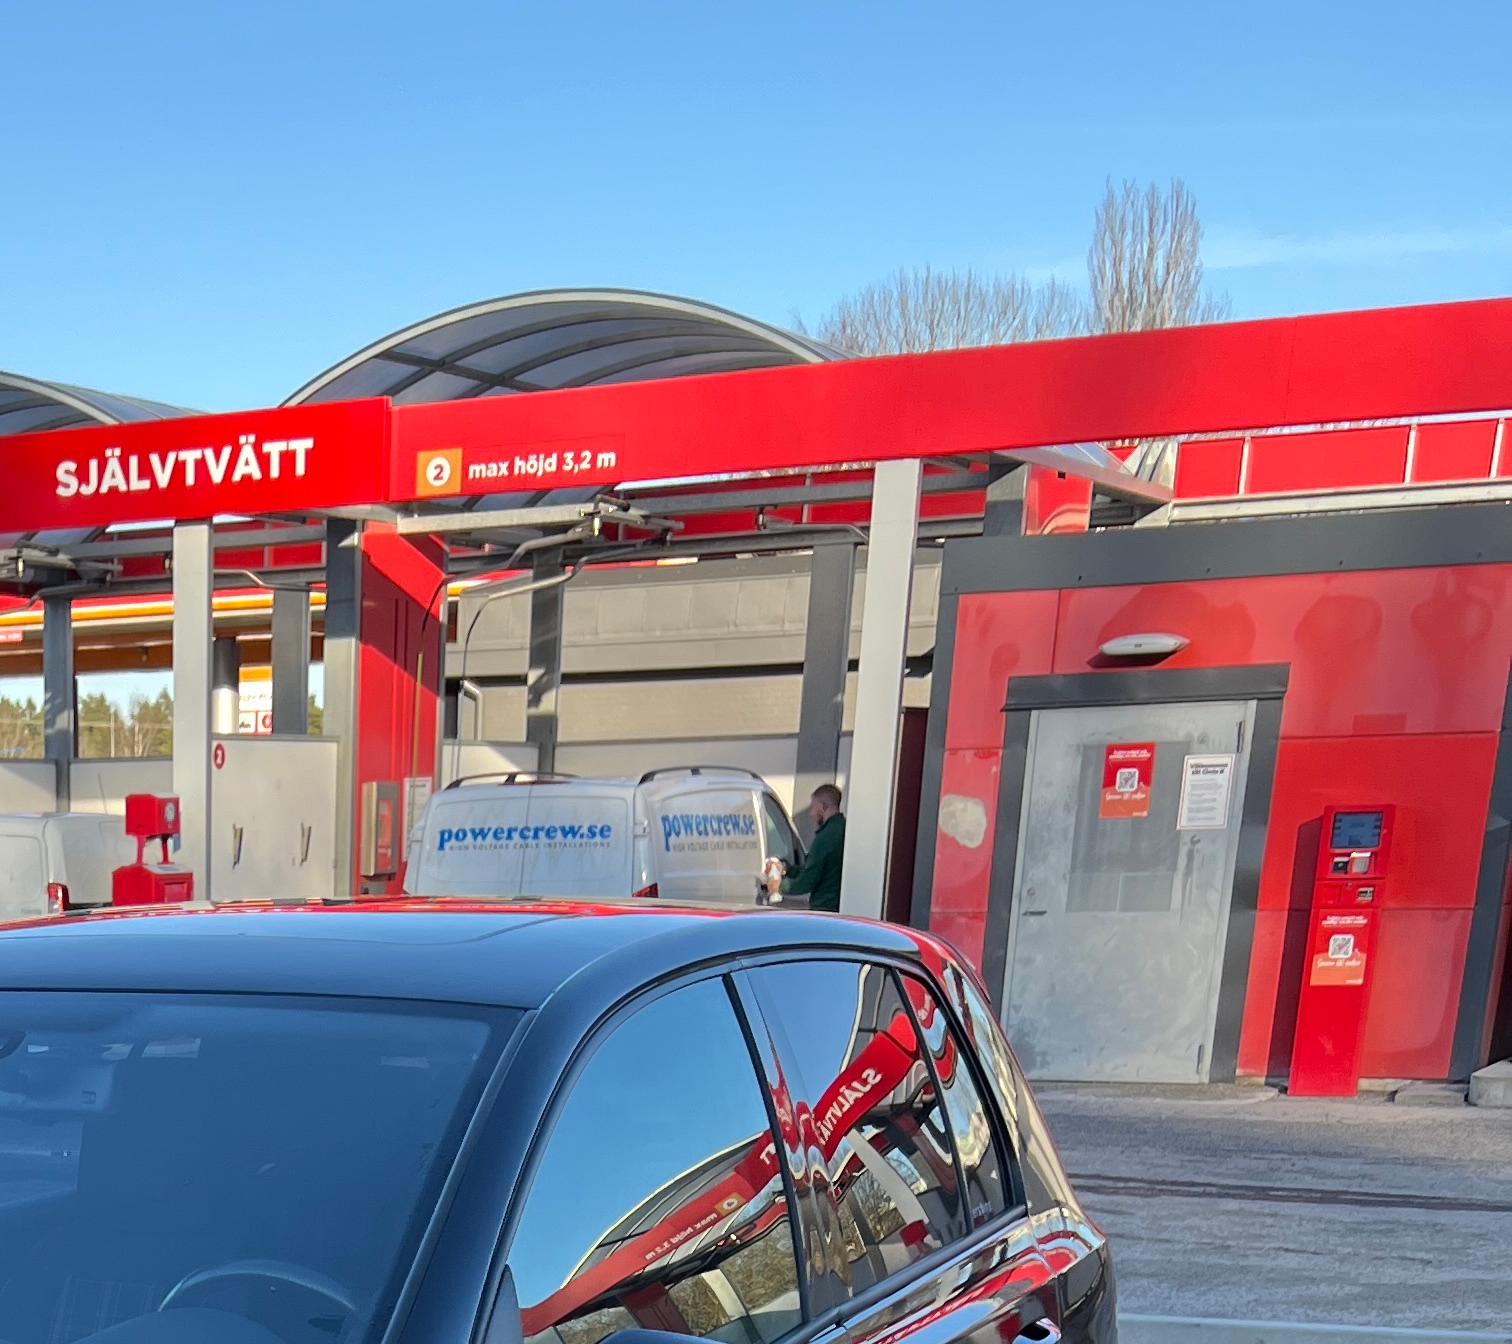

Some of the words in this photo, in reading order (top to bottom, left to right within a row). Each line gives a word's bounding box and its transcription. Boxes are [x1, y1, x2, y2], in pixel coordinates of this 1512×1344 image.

[55, 434, 315, 497] SJÄLVTVÄTT
[468, 461, 509, 480] max
[514, 453, 557, 477] höjd
[562, 450, 592, 473] 3,2
[596, 451, 617, 469] m
[438, 823, 612, 851] powercrew.se
[661, 813, 755, 852] powercrew.se
